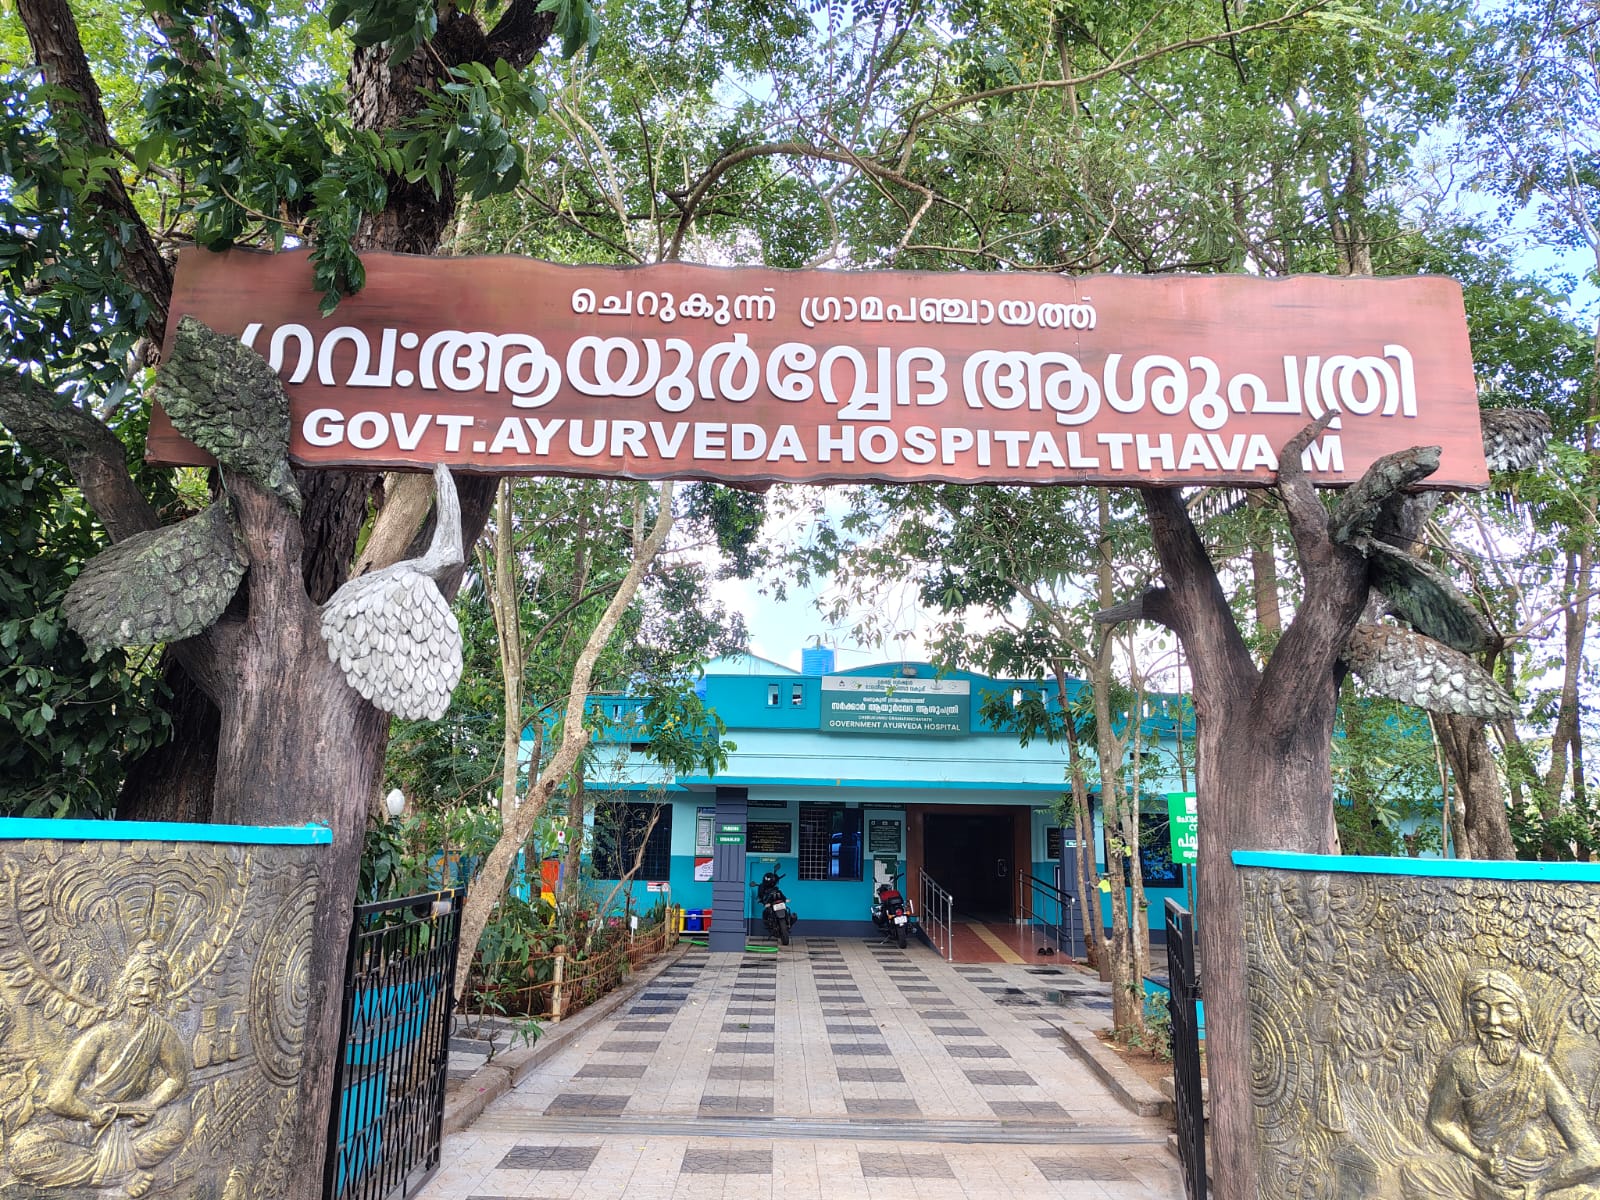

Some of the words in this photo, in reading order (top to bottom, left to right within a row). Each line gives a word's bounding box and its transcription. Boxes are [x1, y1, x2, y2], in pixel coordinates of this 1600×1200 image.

[571, 287, 777, 326] ചെറുകുന്ന്
[800, 296, 1097, 329] ഗ്രാമപഞ്ചായത്ത്
[962, 344, 1417, 430] ആശുപത്രി
[817, 424, 1100, 468] HOSPITAL
[829, 720, 881, 728] GOVERNMENT
[883, 721, 922, 730] AYURVEDA
[924, 723, 961, 731] HOSPITAL
